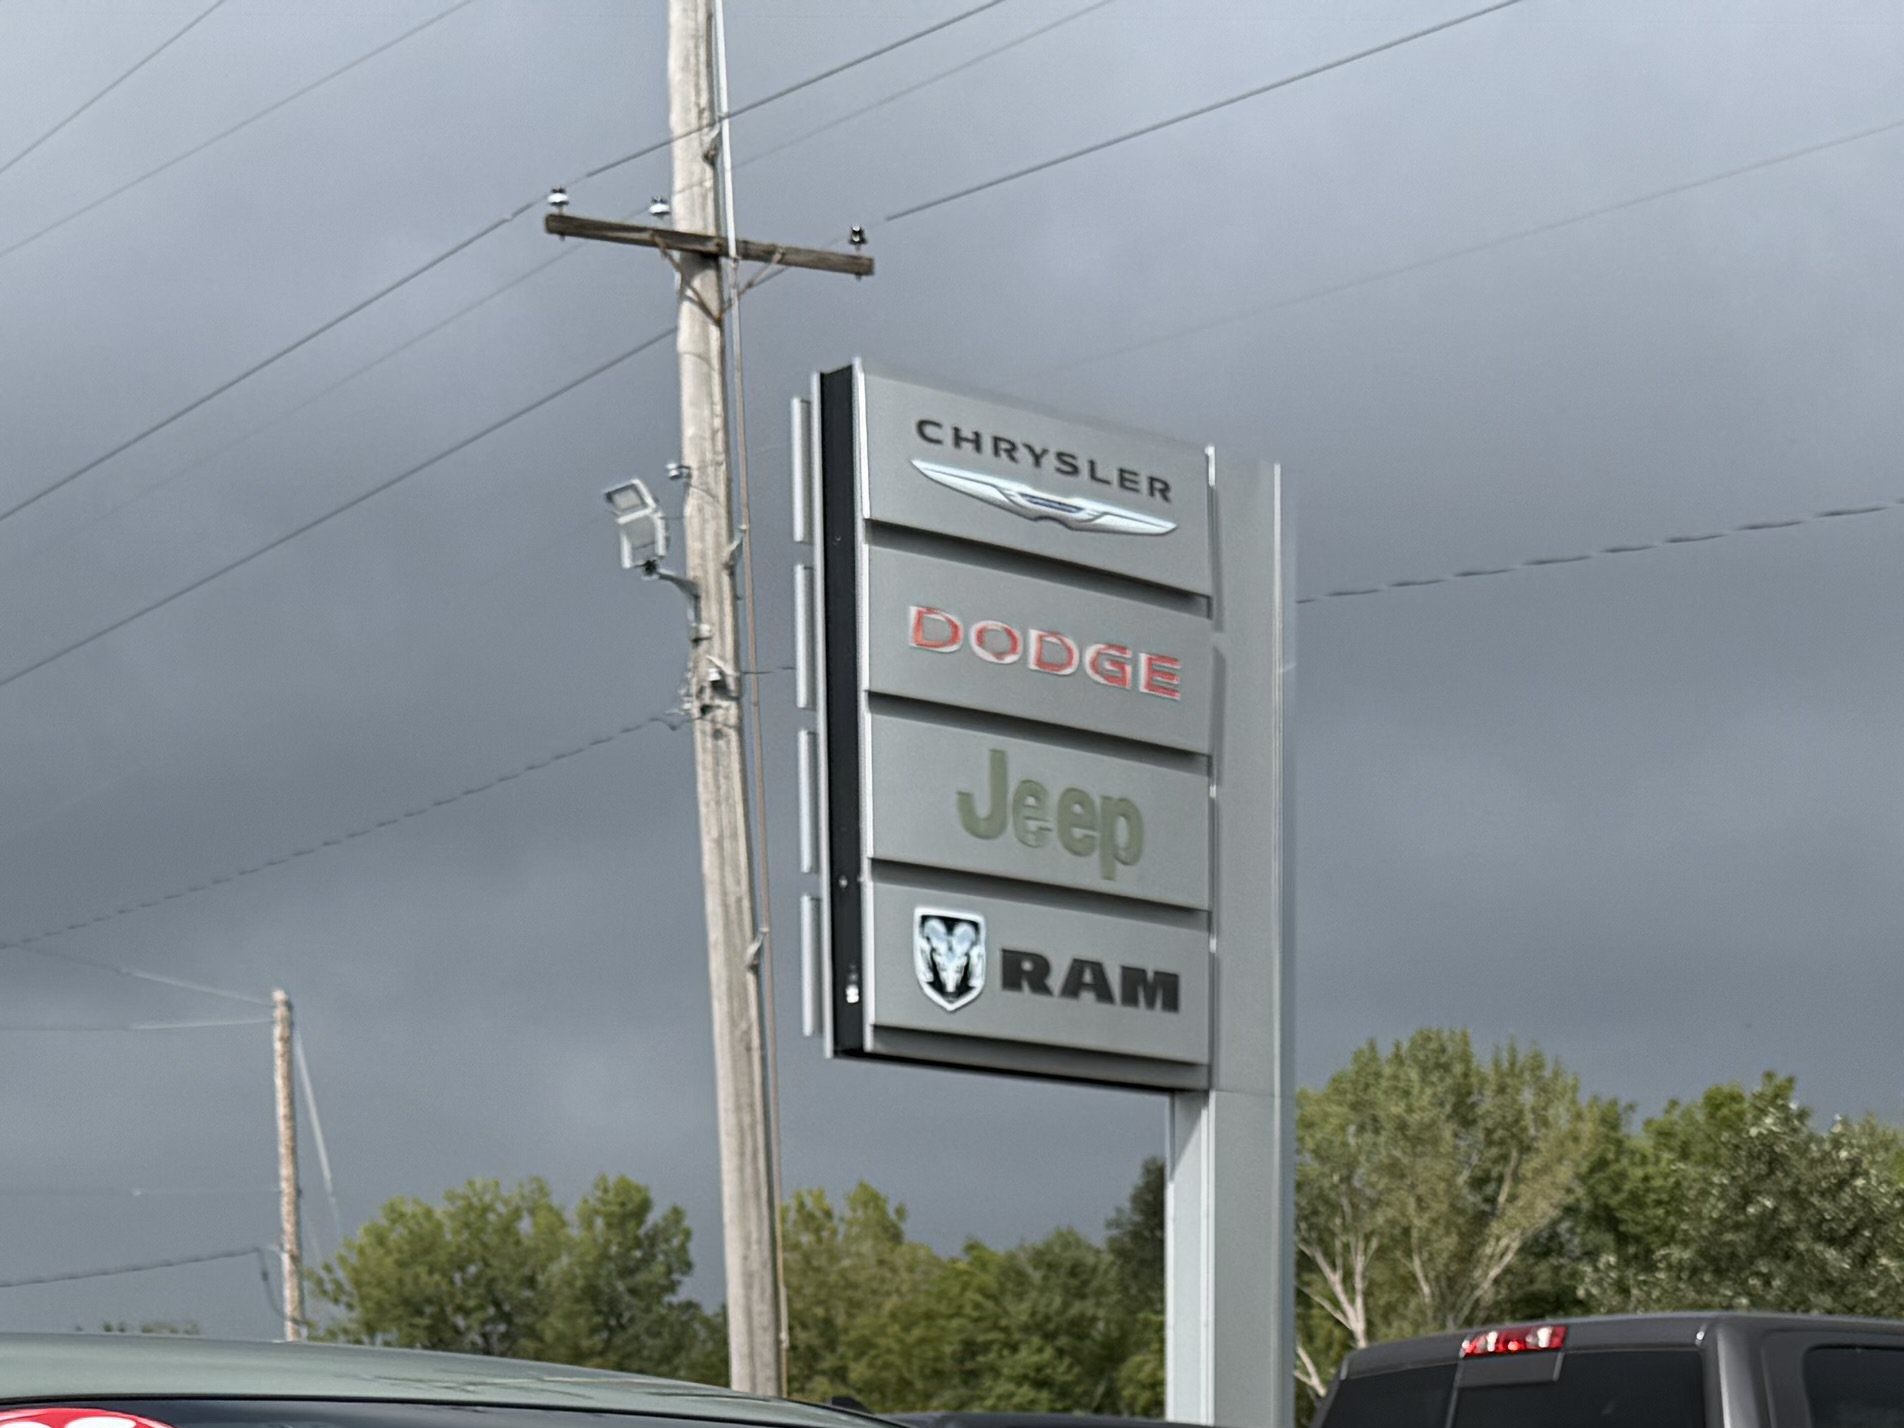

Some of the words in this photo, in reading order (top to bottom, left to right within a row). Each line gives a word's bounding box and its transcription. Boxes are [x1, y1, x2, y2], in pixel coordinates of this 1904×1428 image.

[916, 417, 1173, 502] CHRYSLER
[907, 604, 1182, 701] DODGE
[956, 748, 1146, 881] Jeep
[1000, 947, 1181, 1015] RAM
